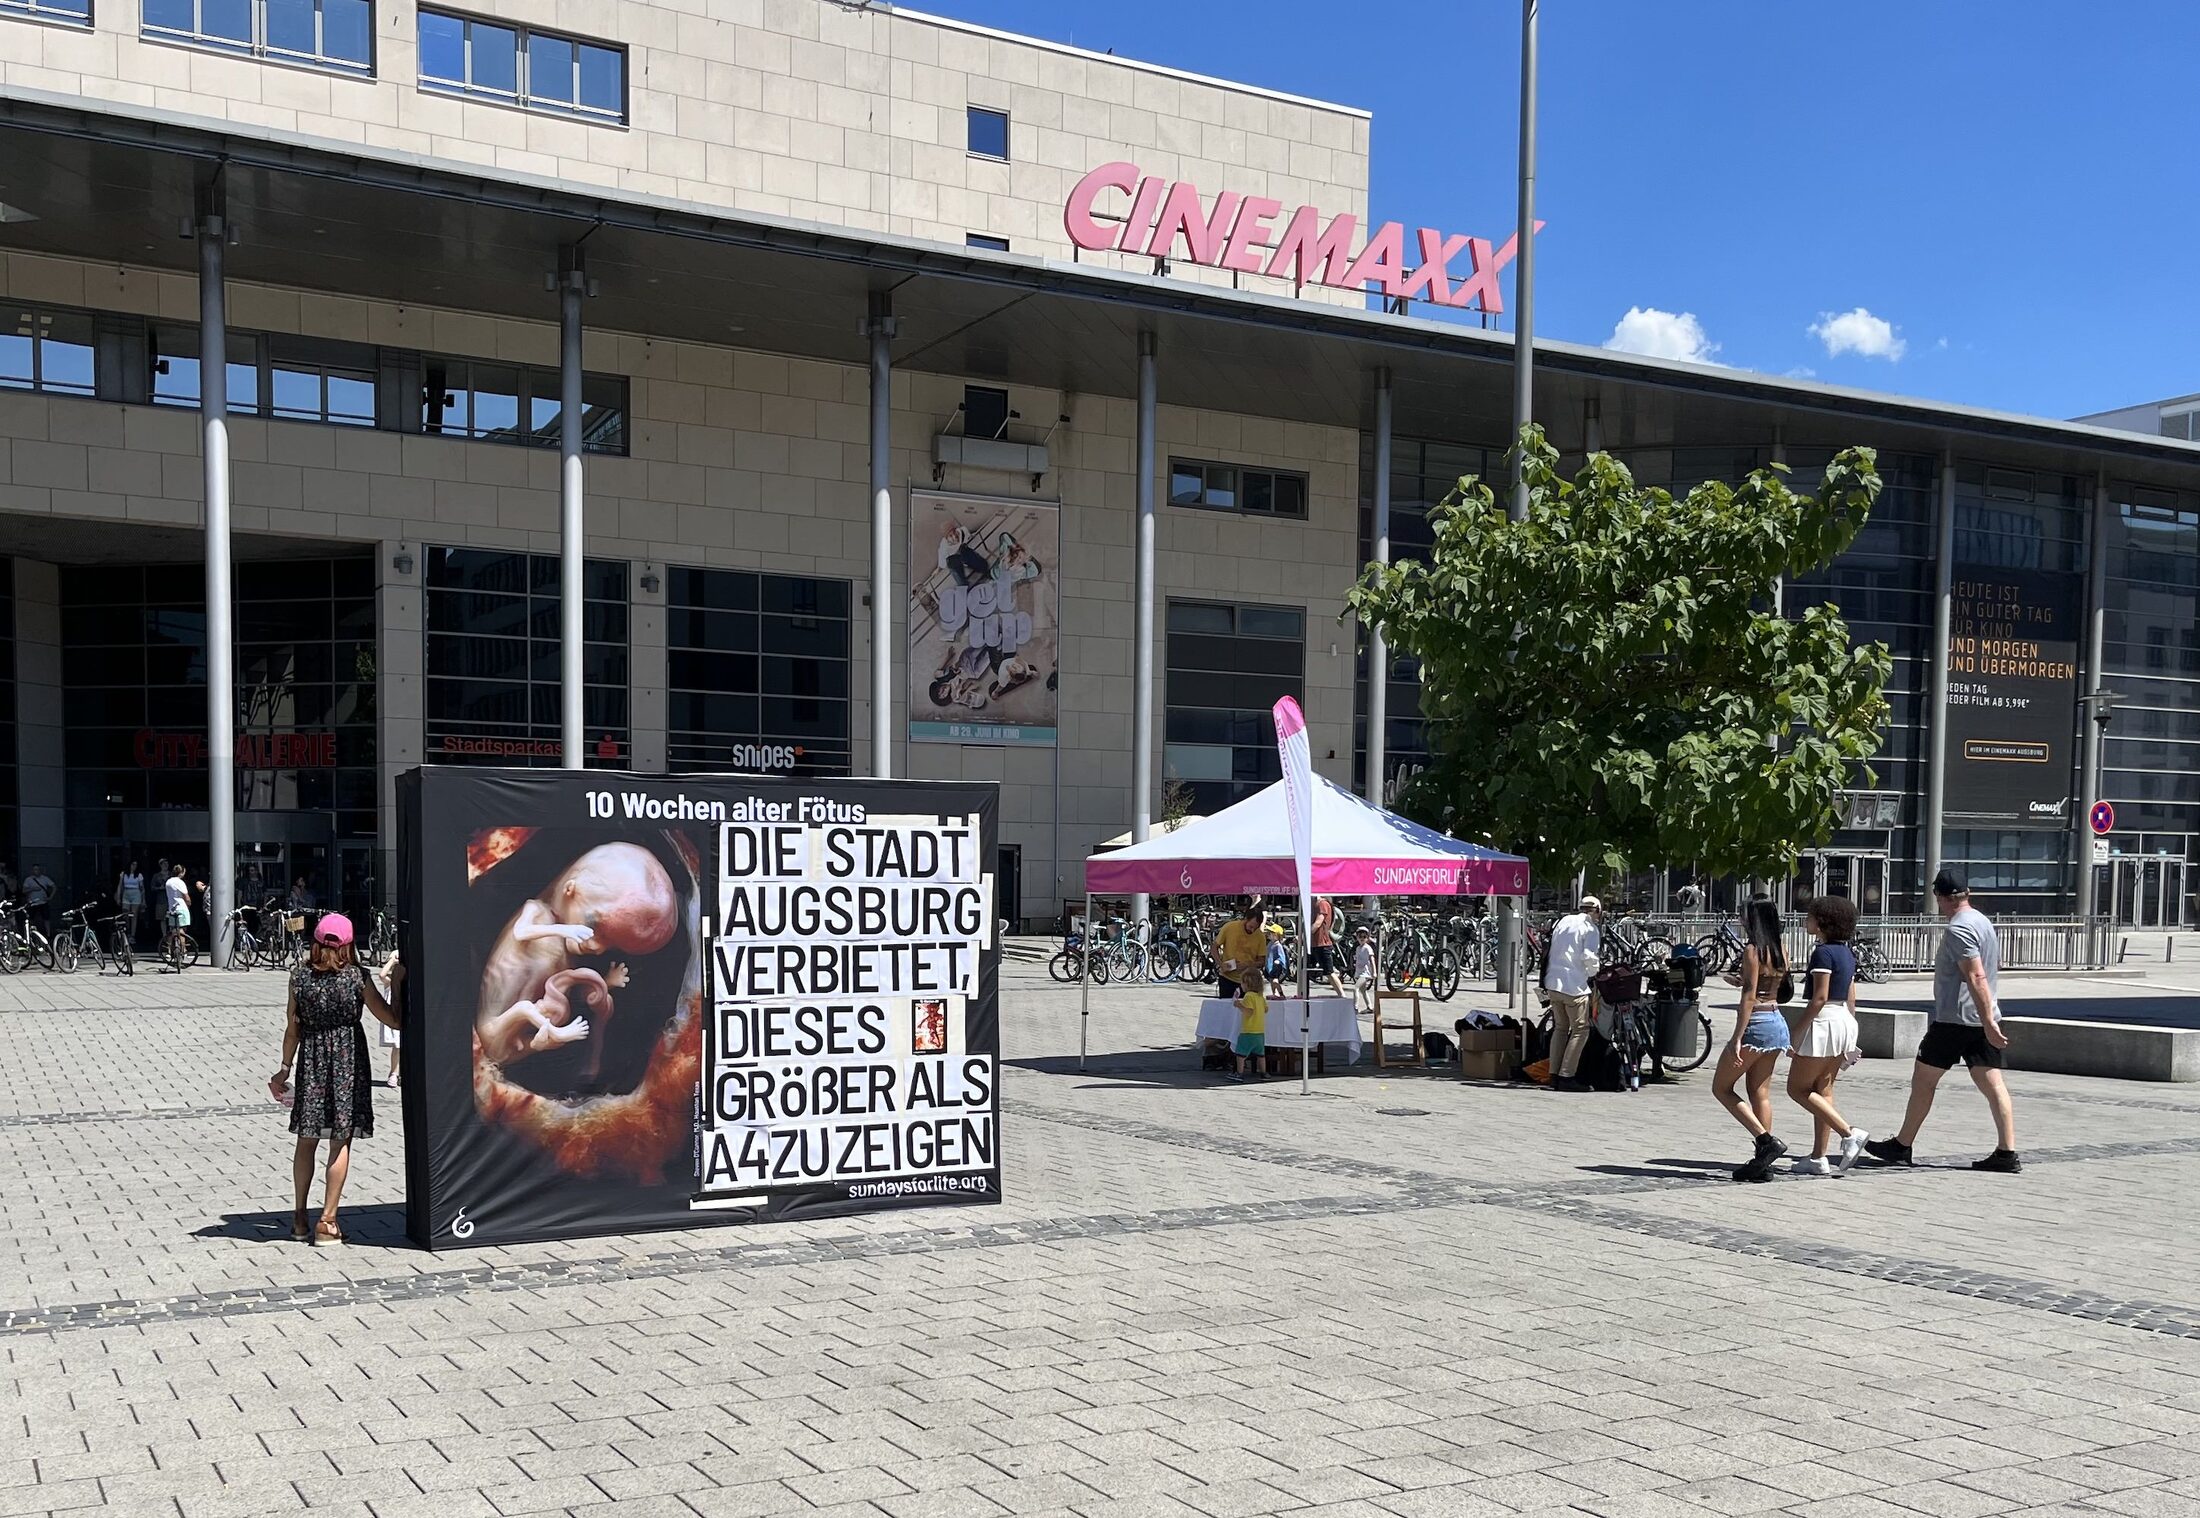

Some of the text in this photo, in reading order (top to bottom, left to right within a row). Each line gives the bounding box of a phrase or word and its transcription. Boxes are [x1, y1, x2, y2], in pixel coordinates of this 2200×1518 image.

[1064, 162, 1545, 314] CINEMAXX
[1998, 586, 2020, 602] IST
[1951, 599, 2052, 623] IN GUTER TAG
[1951, 616, 2013, 639] ÜR KINO
[1981, 639, 2038, 659] MORGEN
[1980, 655, 2074, 680] ÜBERMORGEN
[1971, 695, 1990, 706] FILM
[1992, 697, 2003, 707] AB
[1972, 684, 1987, 695] TAG
[134, 727, 337, 768] CITY-ALERIE
[444, 736, 563, 757] Stadtsparkas
[585, 791, 866, 823] 10 Wochen alter Fötus
[727, 826, 969, 879] DIE STADT
[1374, 867, 1470, 885] SUNDAYSFORLIFE
[724, 885, 981, 936] AUGSBURG
[715, 942, 970, 996] VERBIETET,
[720, 1004, 886, 1060] DIESES
[906, 1058, 990, 1111] ALS
[849, 1175, 987, 1198] sundaysforlife.org
